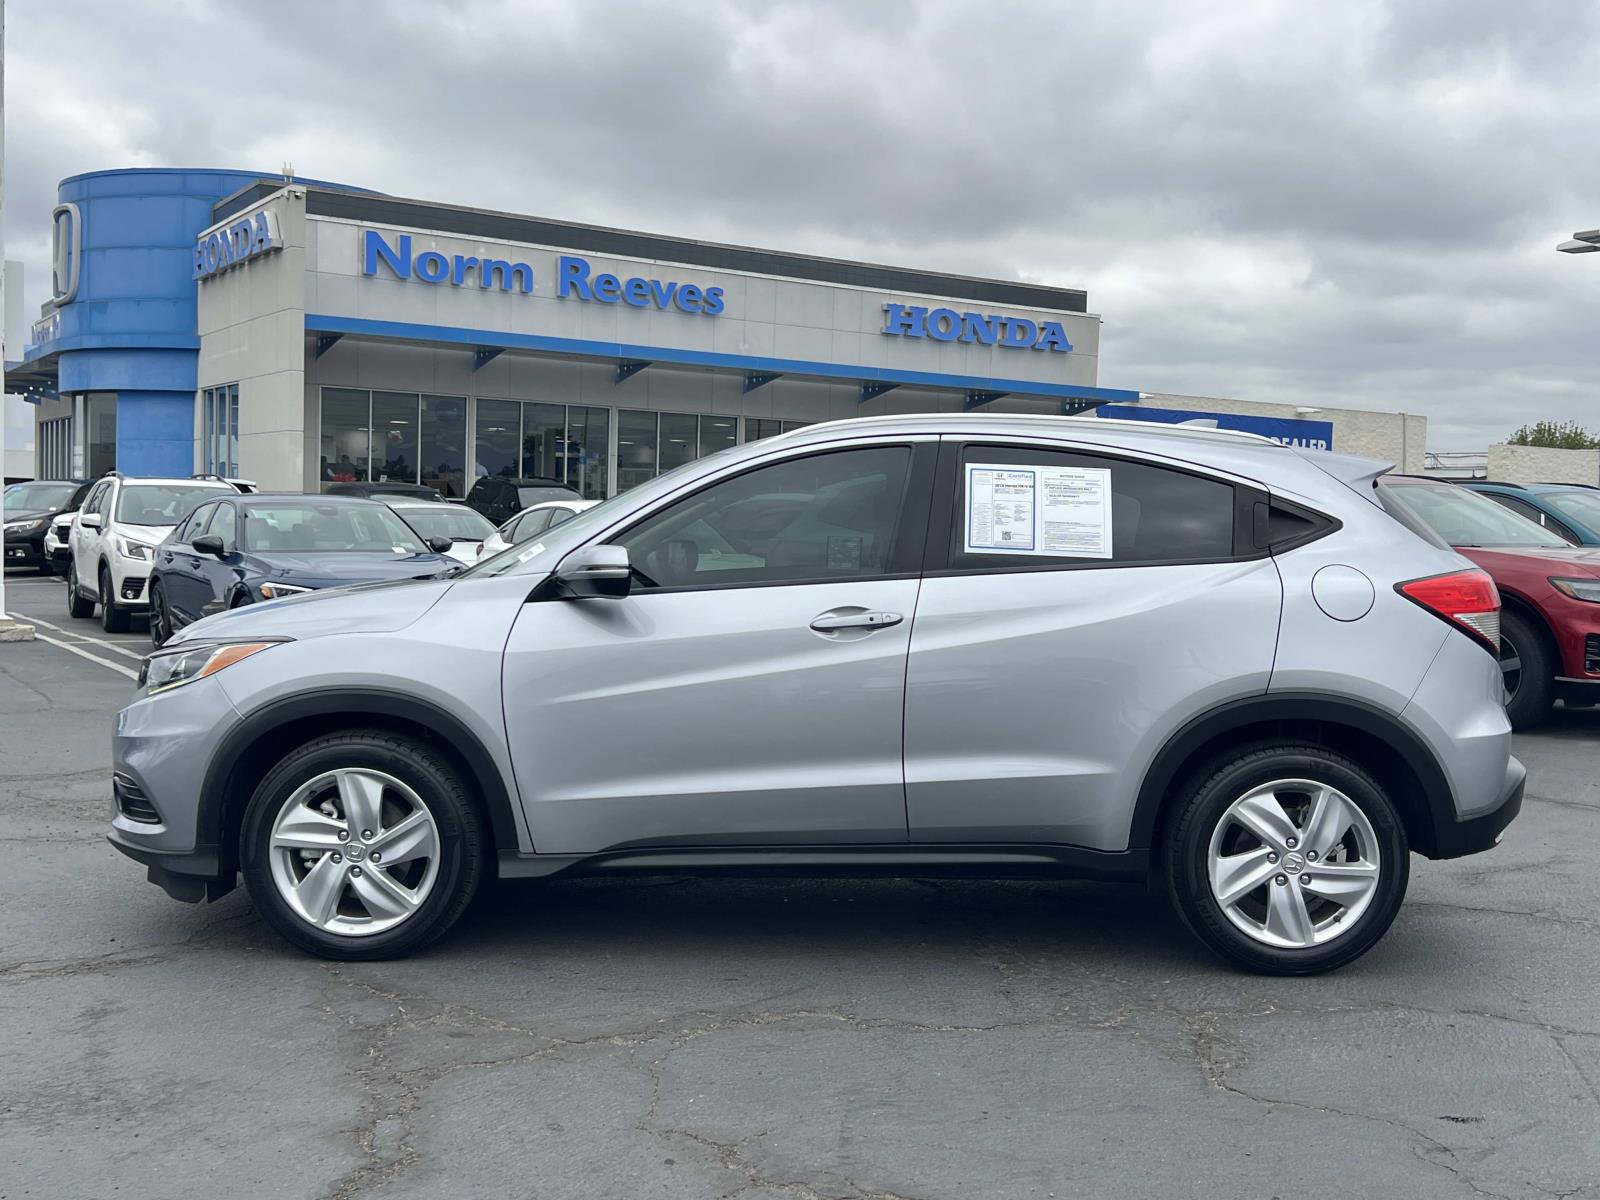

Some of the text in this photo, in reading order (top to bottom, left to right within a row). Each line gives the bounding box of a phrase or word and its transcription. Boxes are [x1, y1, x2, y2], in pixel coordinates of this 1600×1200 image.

[192, 211, 272, 279] HONDA
[363, 231, 724, 315] Norm Reeves
[881, 303, 1073, 352] HONDA
